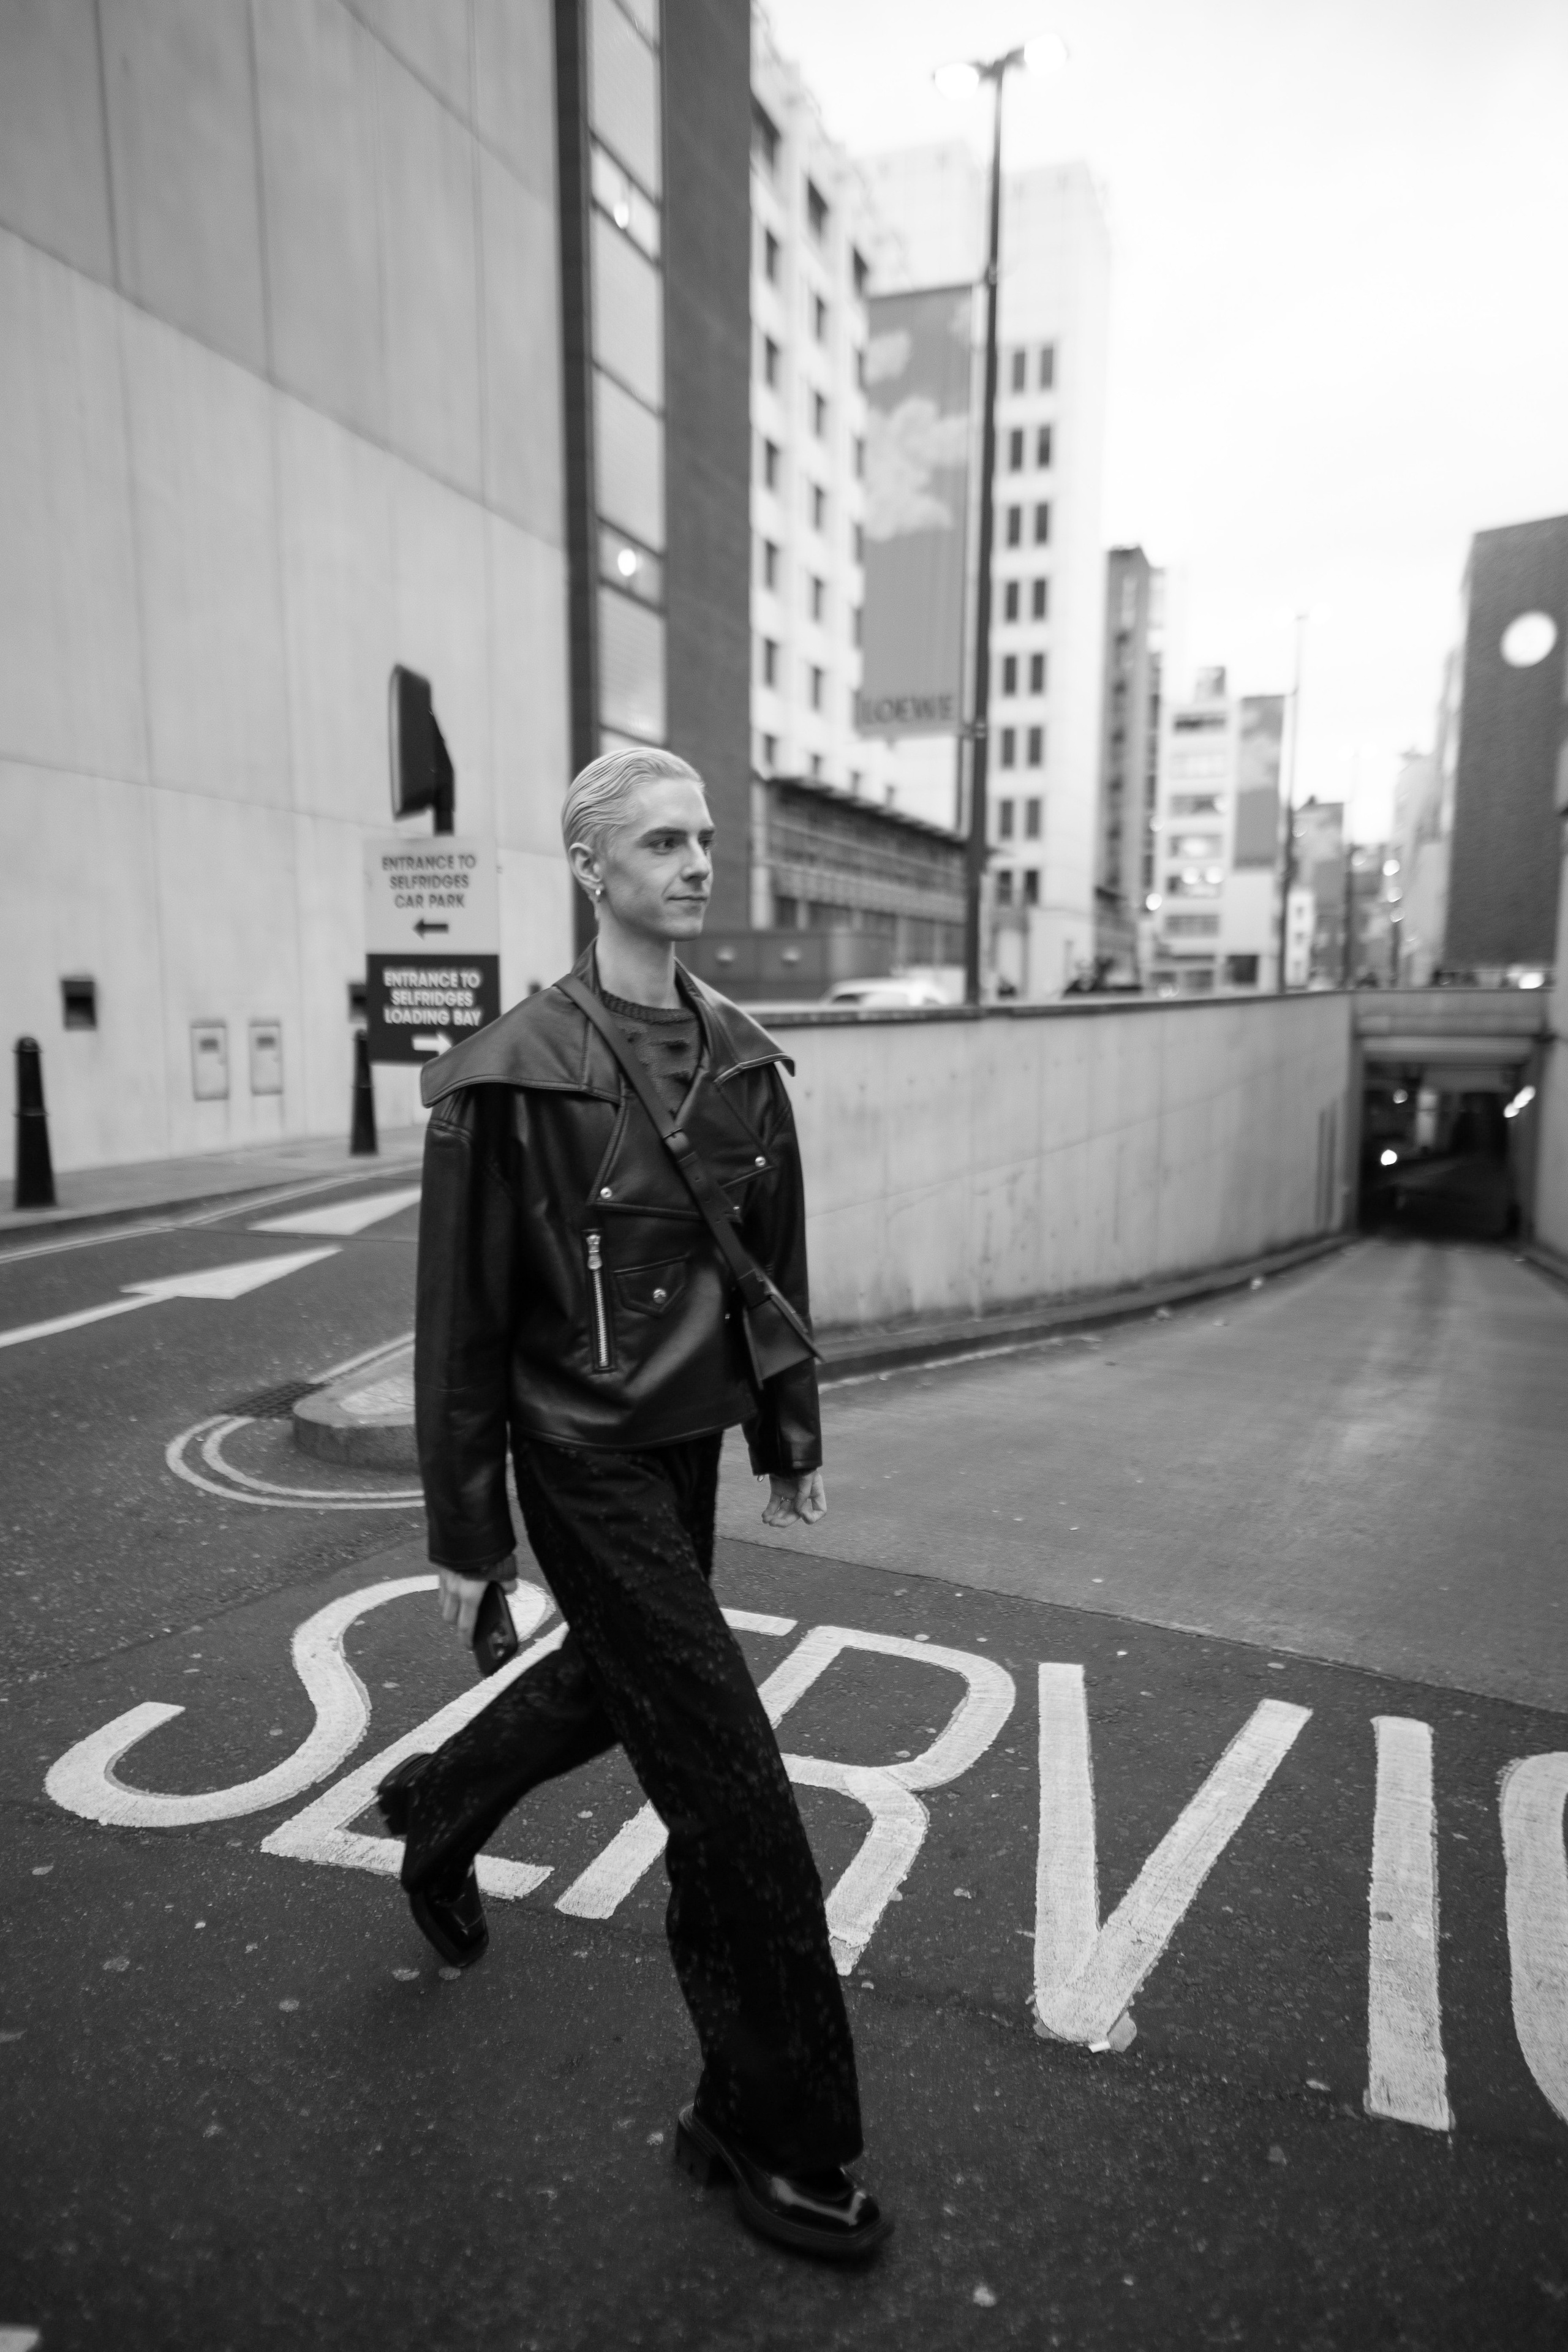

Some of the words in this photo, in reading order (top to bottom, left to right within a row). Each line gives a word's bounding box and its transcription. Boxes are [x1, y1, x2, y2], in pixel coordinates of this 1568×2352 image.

[382, 856, 454, 871] ENTRANCE
[458, 854, 477, 869] TO
[389, 874, 469, 890] SELFRIDGES
[394, 894, 424, 908] CAR
[429, 894, 466, 908] PARK
[383, 970, 459, 988] ENTRANCE
[460, 971, 481, 989] TO
[390, 990, 473, 1007] SELFRIDGES
[383, 1009, 450, 1025] LOADING
[453, 1009, 482, 1027] BAY
